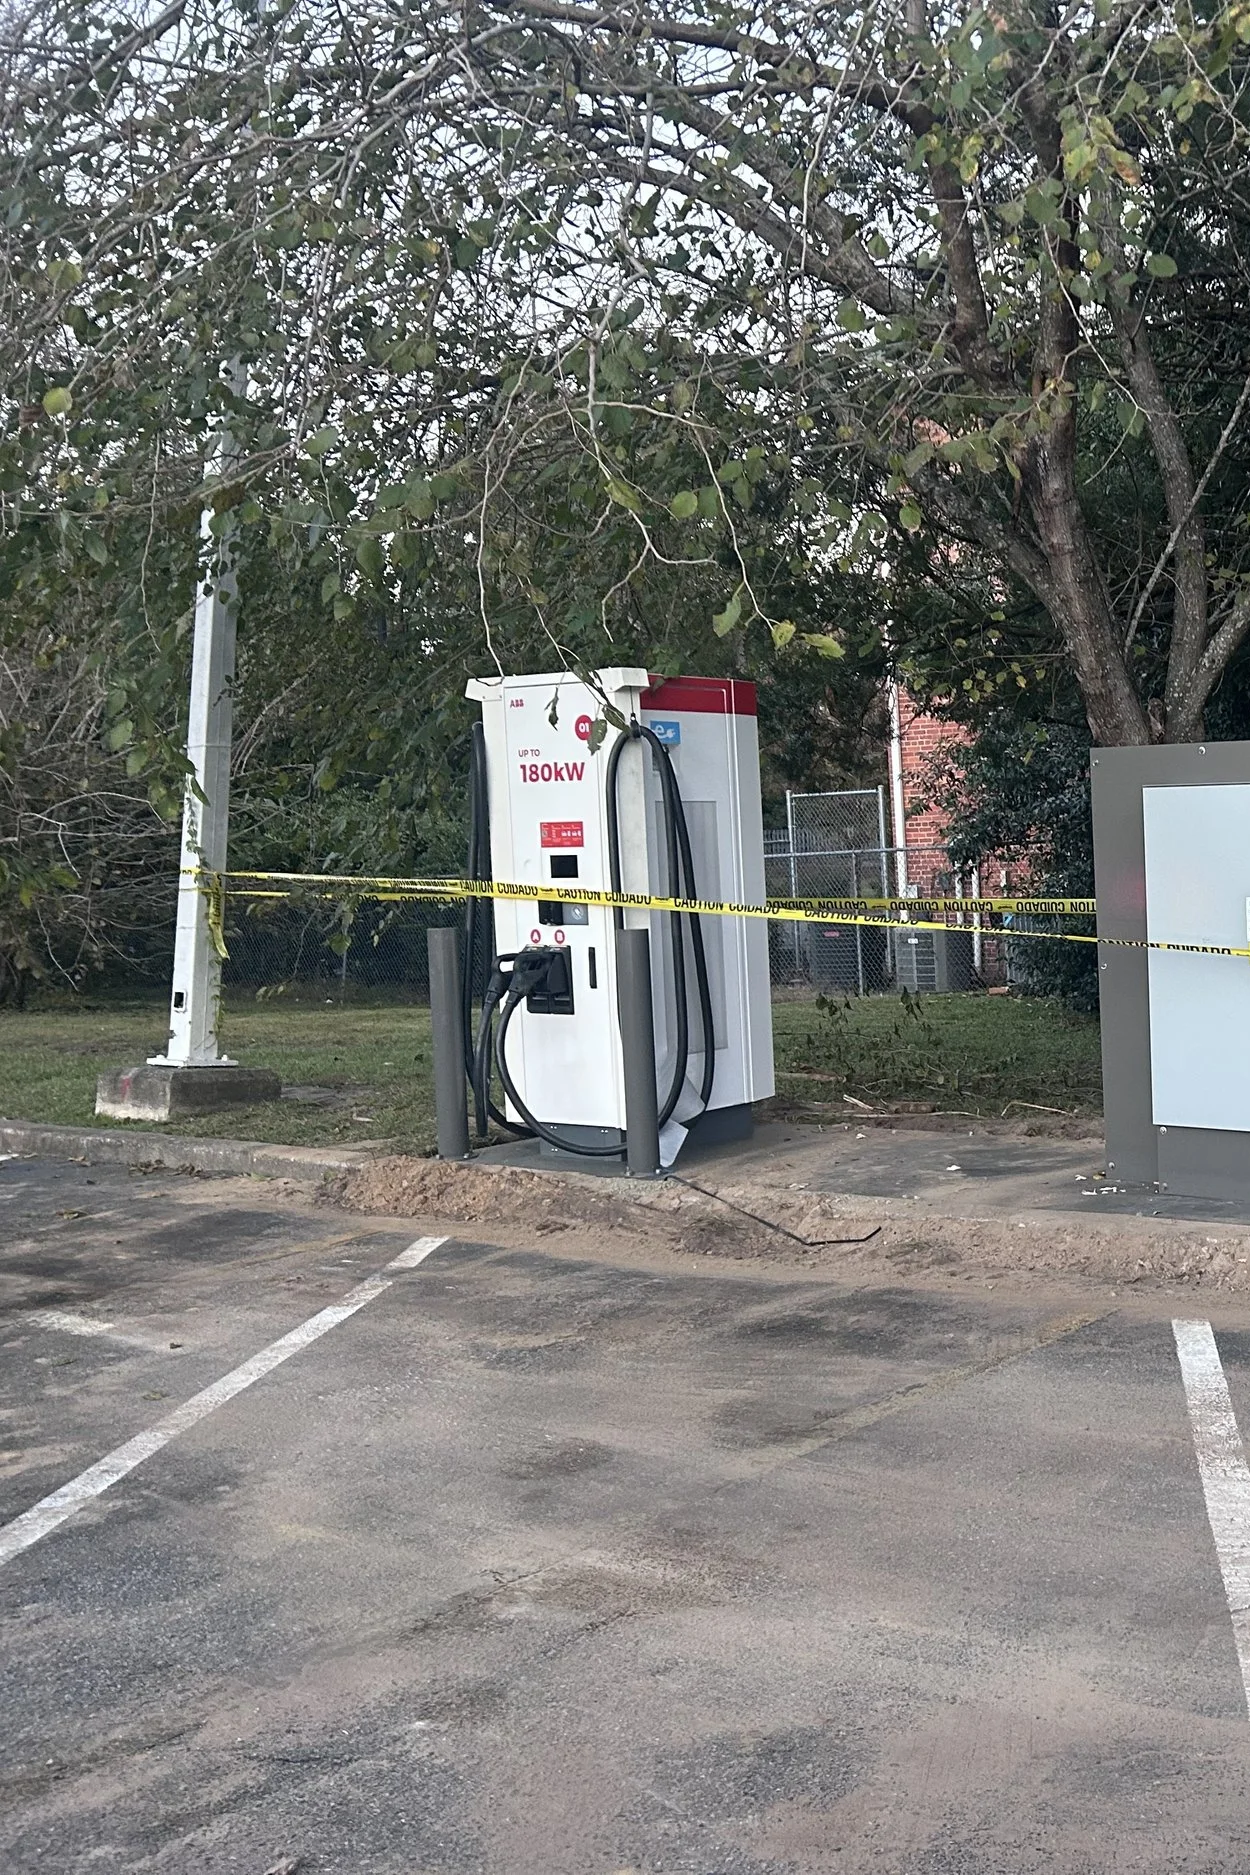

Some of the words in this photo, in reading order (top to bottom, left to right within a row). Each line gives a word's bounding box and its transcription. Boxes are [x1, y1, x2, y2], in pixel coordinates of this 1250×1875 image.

[510, 698, 524, 708] ABB
[518, 749, 529, 757] UP
[530, 749, 540, 757] TO
[520, 762, 585, 783] 180kW
[890, 901, 938, 911] CUIDADO
[944, 901, 993, 912] CAUTION
[1016, 901, 1065, 912] CUIDADO
[1070, 902, 1097, 912] TION
